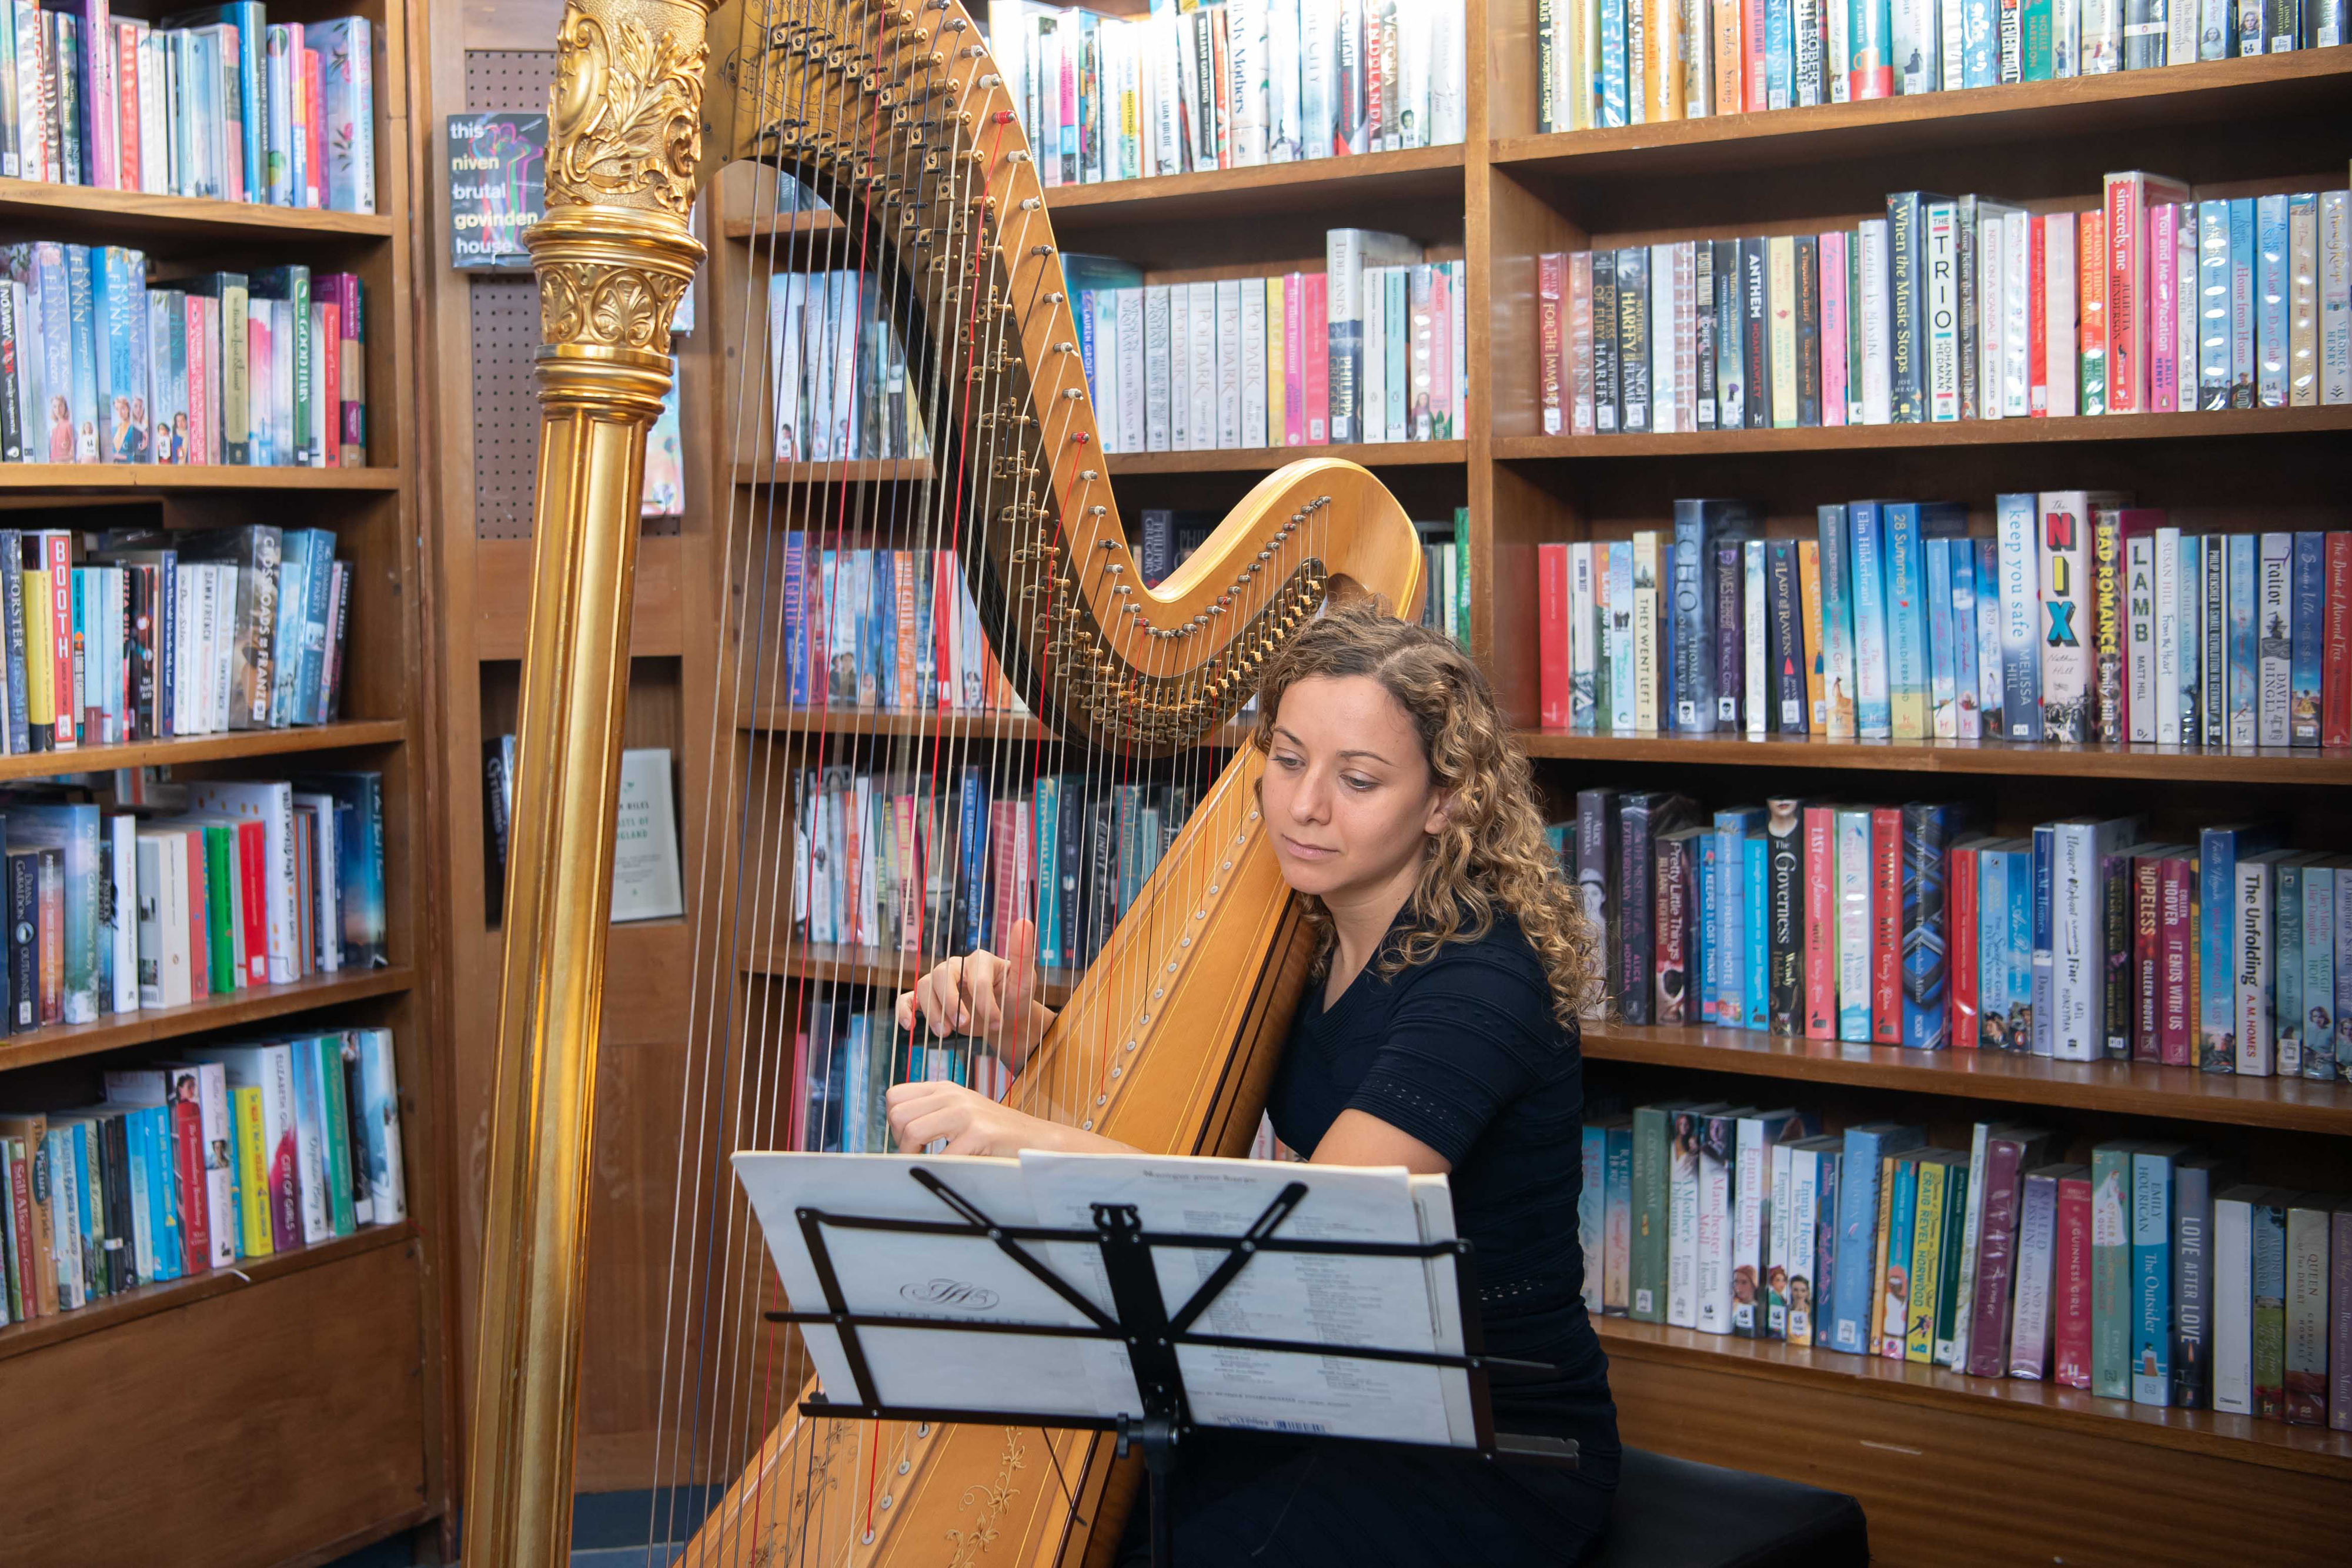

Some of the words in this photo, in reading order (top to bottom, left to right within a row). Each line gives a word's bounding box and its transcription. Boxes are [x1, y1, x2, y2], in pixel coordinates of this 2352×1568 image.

[2002, 9, 2016, 49] STEVEN
[2029, 15, 2037, 67] HARRISON
[1201, 63, 1209, 103] GOLDING
[1234, 49, 1247, 114] Mothers
[2003, 55, 2017, 81] HALL
[1162, 100, 1170, 119] LUAN
[450, 122, 484, 139] this
[452, 154, 499, 170] niven
[452, 183, 506, 199] brutal
[454, 212, 538, 229] govinden
[1895, 205, 1909, 252] When
[2114, 189, 2129, 248] sincerely,
[2158, 214, 2170, 236] You
[456, 238, 513, 254] house
[2116, 251, 2127, 271] me
[2159, 238, 2170, 260] and
[1335, 241, 1347, 316] TIDELANDS
[1896, 255, 1909, 278] the
[1934, 236, 1952, 329] TRIO
[2159, 263, 2169, 281] Me
[2237, 268, 2248, 300] Home
[0, 289, 13, 309] NO
[70, 256, 85, 323] FLYNN
[109, 273, 122, 336] FLYNN
[1594, 285, 1605, 302] OF
[1749, 255, 1762, 318] ANTHEM
[1896, 280, 1910, 327] Music
[1, 308, 14, 340] WAY
[1594, 307, 1605, 339] FURY
[1606, 284, 1615, 339] FORTRESS
[2112, 275, 2120, 340] HENDERSON
[2122, 283, 2130, 331] JULIETTA
[2236, 303, 2249, 329] from
[298, 318, 308, 365] GOOD
[2159, 302, 2170, 352] Vacation
[1221, 308, 1238, 398] POLDARK
[1243, 302, 1261, 393] POLDARK
[1895, 330, 1910, 373] Stops
[2237, 331, 2249, 365] Home
[2327, 331, 2336, 366] HENRY
[2337, 321, 2346, 375] VERONICA
[1595, 343, 1606, 407] HARFFY
[1752, 356, 1761, 398] HAWLEY
[1936, 343, 1945, 389] HEDMAN
[1339, 356, 1352, 418] PHILIPPA
[1857, 511, 1869, 534] Elin
[1894, 514, 1906, 531] 28
[2005, 509, 2026, 553] keep
[315, 540, 325, 578] HOUSE
[2097, 526, 2115, 561] BAD
[2209, 550, 2220, 571] PHILIP
[2333, 541, 2346, 556] The
[1859, 536, 1872, 606] Hilderbrand
[1895, 534, 1909, 596] Summers
[2006, 560, 2024, 594] you
[2046, 512, 2080, 647] NIX
[2333, 560, 2347, 589] Bride
[55, 541, 69, 659] BOOTH
[312, 580, 322, 616] PARTY
[321, 563, 331, 610] SUMMER
[340, 571, 349, 606] ESTHER
[2133, 546, 2150, 642] LAMB
[2209, 573, 2220, 602] HENSHER
[10, 574, 23, 649] FORSTER
[337, 609, 346, 640] FREUD
[1639, 599, 1649, 631] THEY
[2012, 601, 2029, 638] safe
[2098, 567, 2116, 654] ROMANCE
[2209, 610, 2220, 631] SMALL
[2332, 601, 2347, 640] Almond
[1640, 634, 1649, 673] WENT
[2137, 656, 2146, 680] MATT
[2333, 643, 2348, 662] Tree
[1641, 678, 1649, 704] LEFT
[2007, 663, 2017, 691] HILL
[2018, 647, 2032, 706] MELISSA
[2100, 662, 2114, 697] Emily
[2137, 683, 2146, 701] HILL
[2101, 699, 2114, 721] Hill
[2209, 683, 2221, 714] GERMANY
[1668, 842, 1681, 881] Pretty
[1775, 840, 1792, 850] The
[16, 860, 25, 920] GABALDON
[25, 872, 33, 905] DIANA
[1669, 884, 1682, 915] Little
[1774, 852, 1797, 944] Governess
[2140, 866, 2156, 936] HOPELESS
[2164, 880, 2179, 925] HOOVER
[2179, 889, 2188, 918] COLLEEN
[2244, 875, 2260, 905] The
[2037, 896, 2046, 935] Homes
[1667, 917, 1682, 961] Things
[2169, 941, 2182, 952] IT
[2240, 907, 2260, 988] Unfolding
[1772, 951, 1784, 988] Holden
[1785, 952, 1797, 988] Wendy
[2168, 954, 2183, 982] ENDS
[2036, 975, 2049, 1002] Days
[2169, 985, 2183, 1014] WITH
[2246, 994, 2256, 1005] A.
[2037, 1006, 2048, 1017] of
[2169, 1017, 2183, 1030] US
[2246, 1007, 2256, 1018] M.
[2037, 1021, 2046, 1044] Awe
[2246, 1020, 2256, 1058] HOMES
[275, 1054, 287, 1108] ELIZABETH
[13, 1164, 26, 1195] Still
[36, 1150, 48, 1201] Picture
[281, 1155, 292, 1179] CITY
[283, 1181, 292, 1196] OF
[1800, 1180, 1812, 1218] Emma
[1920, 1171, 1932, 1206] CRAIG
[2138, 1166, 2149, 1233] HOURICAN
[2151, 1182, 2161, 1220] EMILY
[17, 1197, 28, 1234] Alice
[283, 1198, 294, 1231] GIRLS
[1699, 1213, 1709, 1245] Moll
[1710, 1177, 1725, 1256] Manchester
[1917, 1210, 1930, 1244] REVEL
[1798, 1222, 1812, 1268] Hornby
[2181, 1216, 2201, 1257] LOVE
[2070, 1228, 2082, 1282] GUINNESS
[2144, 1253, 2158, 1274] The
[1913, 1250, 1926, 1307] HORWOOD
[2183, 1261, 2198, 1299] AFTER
[2069, 1286, 2080, 1316] GIRLS
[2144, 1276, 2160, 1334] Outsider
[2180, 1304, 2200, 1345] LOVE
